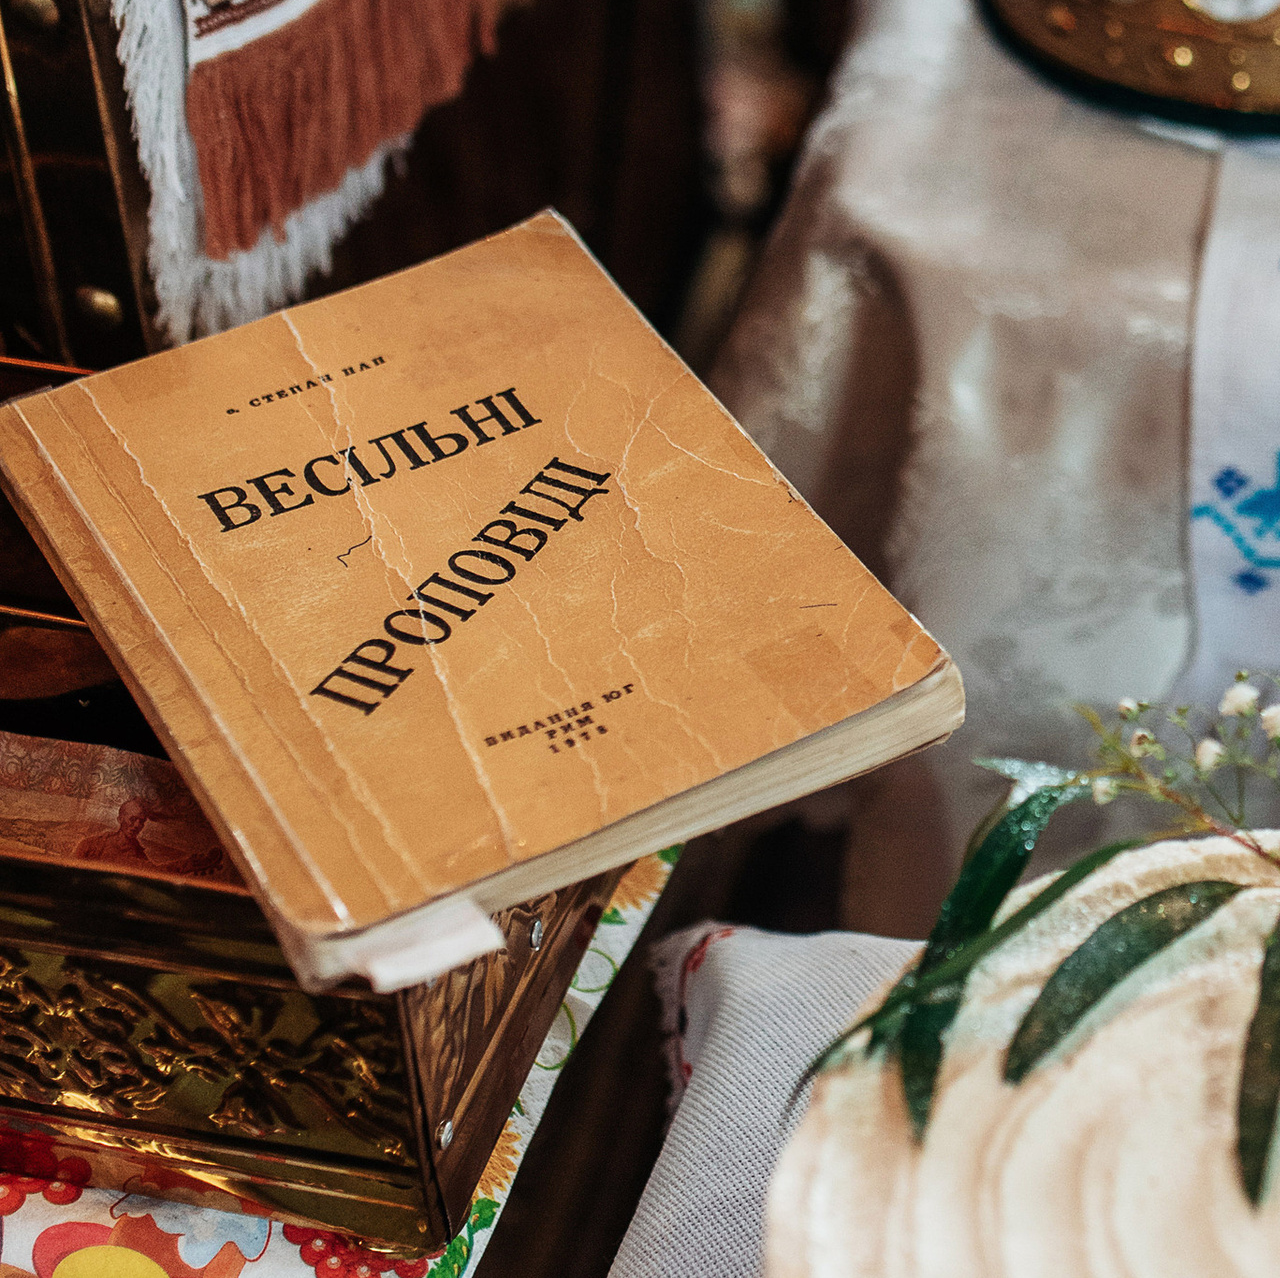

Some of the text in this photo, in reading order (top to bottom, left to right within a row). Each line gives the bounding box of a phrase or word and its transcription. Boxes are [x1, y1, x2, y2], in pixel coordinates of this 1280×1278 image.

[249, 373, 333, 407] СТЕПАН
[198, 387, 542, 532] ВЕСІЛЬНІ
[309, 457, 611, 716] ПРОПОВІДІ
[484, 701, 594, 747] ВИДАННЯ
[545, 715, 594, 740] РИМ
